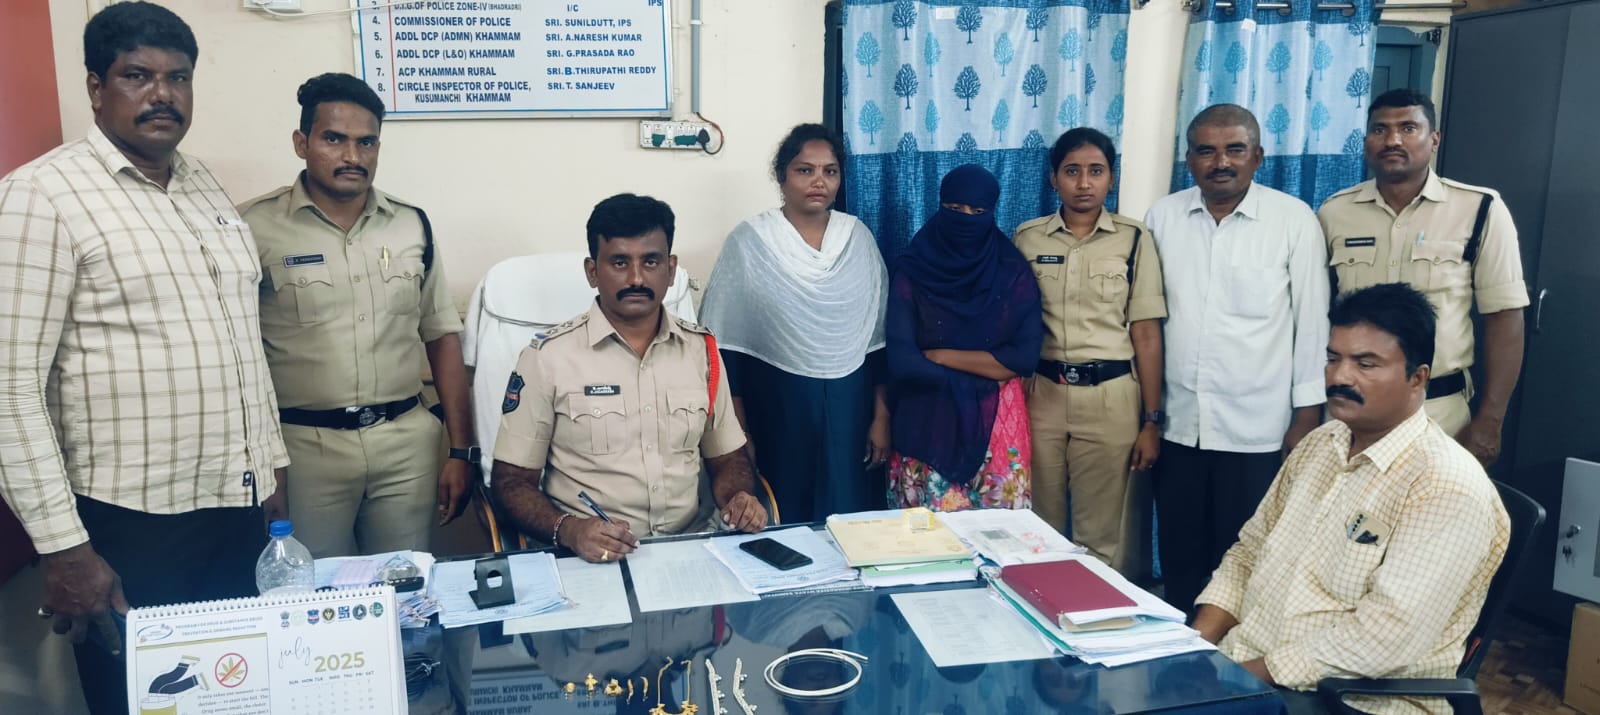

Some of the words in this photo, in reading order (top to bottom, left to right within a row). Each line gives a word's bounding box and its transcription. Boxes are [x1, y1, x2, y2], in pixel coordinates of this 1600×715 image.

[427, 2, 455, 10] POLICE
[457, 2, 487, 11] ZONE-IV
[567, 4, 579, 12] I/C
[372, 16, 381, 25] 4.
[394, 17, 463, 26] COMMISSIONER
[466, 17, 478, 26] OF
[480, 17, 511, 27] POLICE
[545, 19, 563, 27] SRI.
[565, 19, 616, 28] SUNILDUTT,
[618, 19, 632, 27] IPS
[374, 33, 383, 41] 5.
[395, 32, 418, 41] ADDL
[421, 32, 439, 41] DCP
[441, 32, 473, 43] (ADMN)
[475, 32, 521, 41] KHAMMAM
[545, 33, 563, 41] SRI.
[565, 33, 609, 41] A.NARESH
[611, 33, 643, 42] KUMAR
[375, 50, 384, 59] 6.
[397, 50, 420, 59] ADDL
[422, 50, 440, 59] DCP
[443, 50, 467, 60] (L&O)
[469, 50, 515, 59] KHAMMAM
[546, 50, 564, 58] SRI.
[566, 49, 615, 58] G.PRASADA
[617, 49, 635, 57] RAO
[376, 67, 385, 77] 7.
[398, 67, 416, 77] ACP
[419, 67, 465, 77] KHAMMAM
[468, 66, 497, 76] RURAL
[629, 66, 657, 75] REDDY
[378, 83, 386, 92] 8.
[398, 82, 430, 92] CIRCLE
[433, 82, 481, 91] INSPECTOR
[484, 81, 495, 91] OF
[498, 81, 532, 92] POLICE,
[547, 82, 565, 90] SRI.
[575, 82, 615, 90] SANJEEV
[415, 93, 461, 104] KUSUMANCHI
[466, 93, 512, 103] KHAMMAM
[314, 652, 365, 673] 2025
